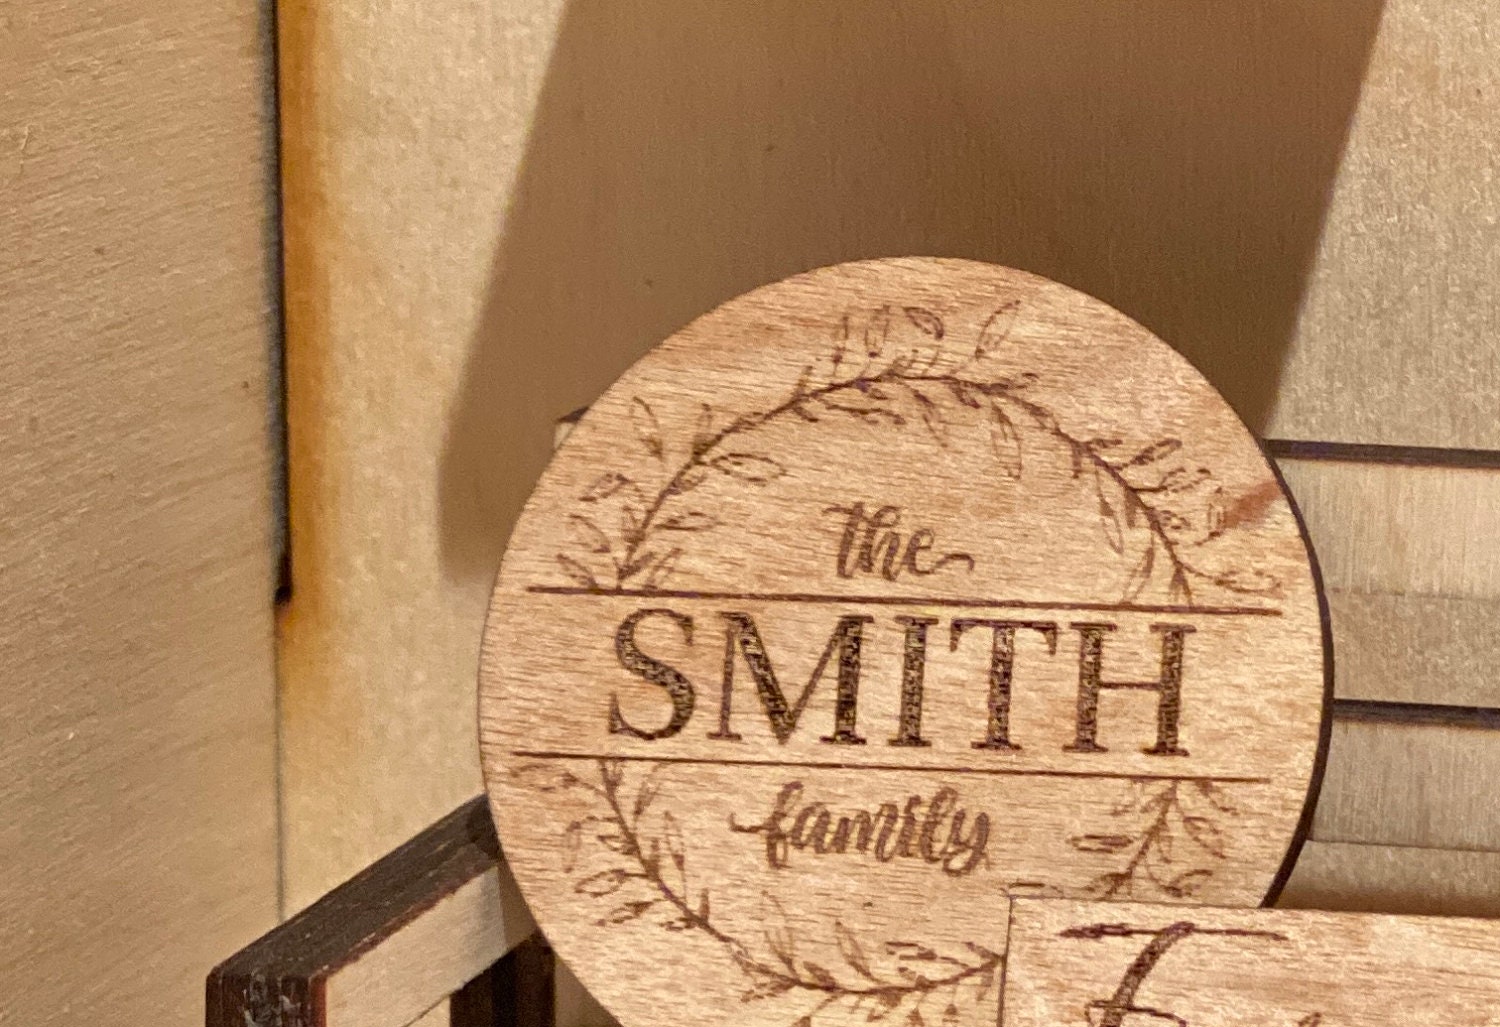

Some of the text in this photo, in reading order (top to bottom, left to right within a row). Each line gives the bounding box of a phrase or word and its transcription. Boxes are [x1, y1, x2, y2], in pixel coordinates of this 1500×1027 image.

[823, 500, 975, 582] the
[607, 606, 1197, 757] SMITH
[728, 780, 991, 877] family
